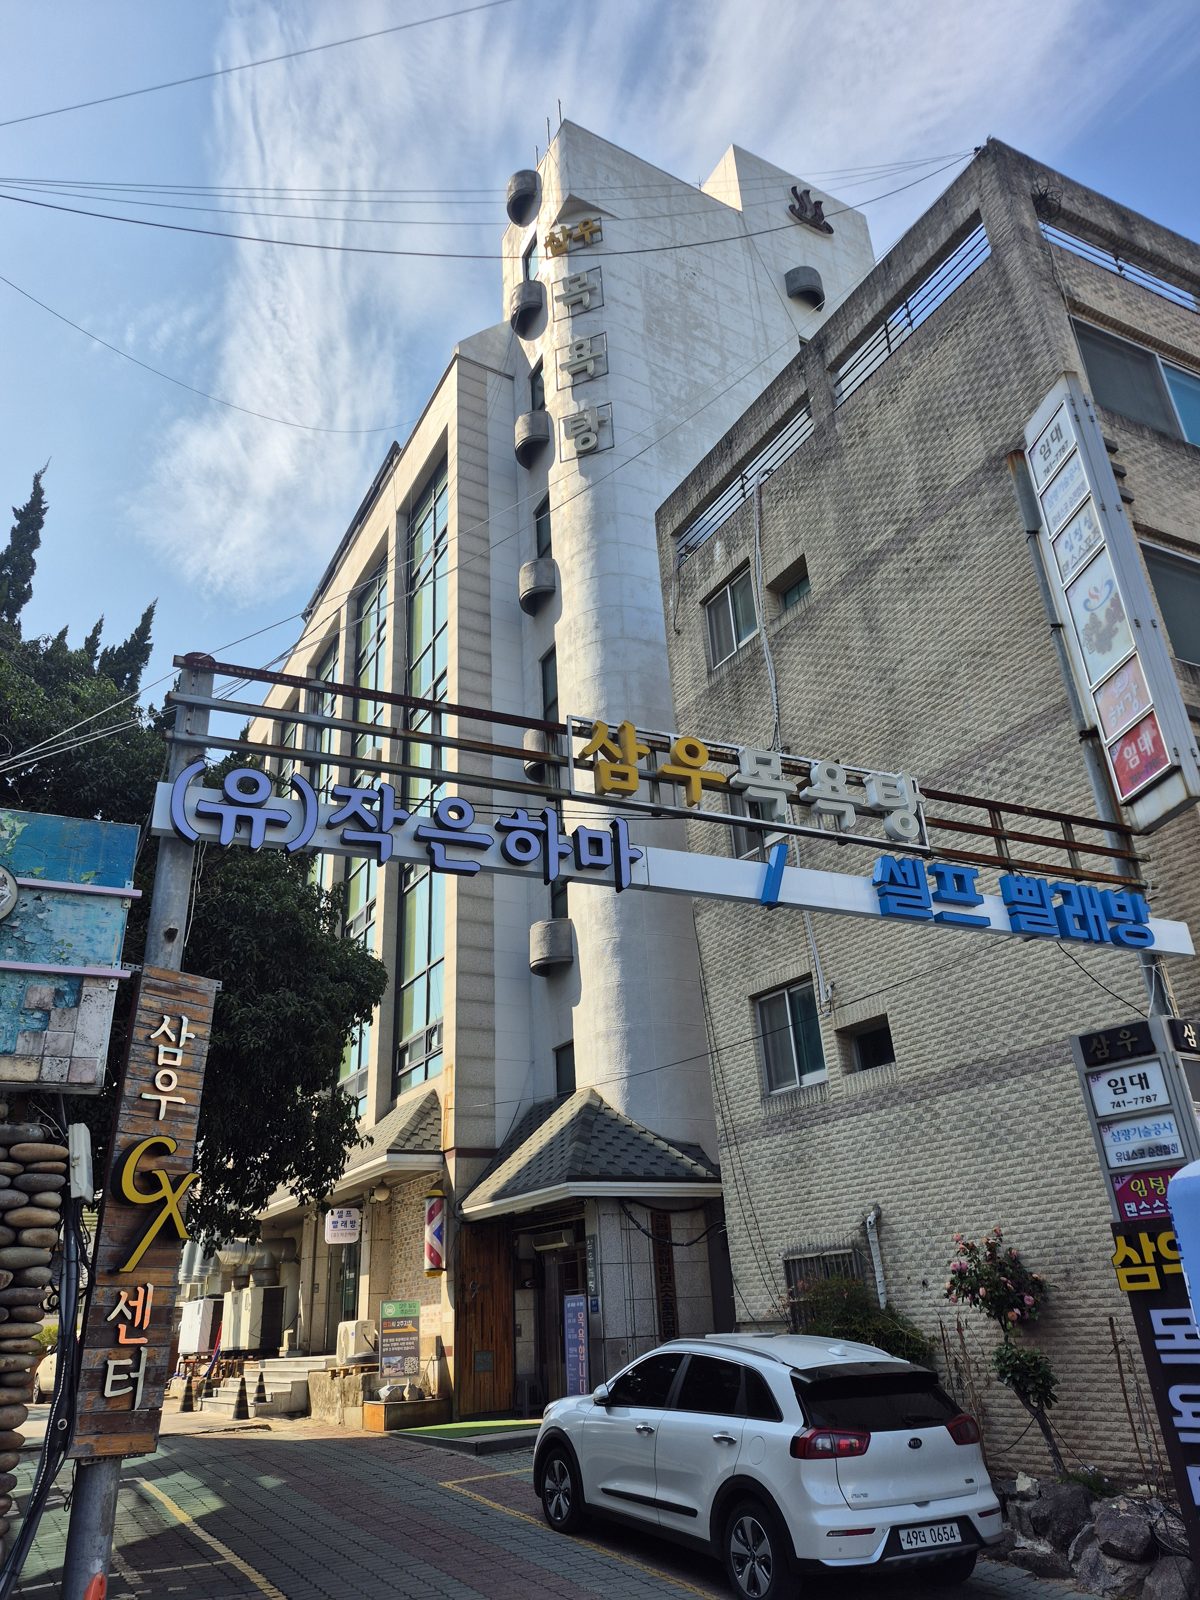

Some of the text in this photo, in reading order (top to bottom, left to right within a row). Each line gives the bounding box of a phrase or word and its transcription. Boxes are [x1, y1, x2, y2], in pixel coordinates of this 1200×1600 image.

[554, 271, 607, 451] 목욕탕
[1040, 422, 1063, 461] 임대
[1123, 730, 1155, 769] 임대
[873, 855, 991, 929] 셀프
[1000, 873, 1156, 949] 빨래방
[1090, 1029, 1138, 1059] 삼우
[1183, 1024, 1197, 1048] 삼
[141, 1014, 195, 1121] 삼우
[1107, 1072, 1150, 1095] 임대
[1110, 1094, 1158, 1109] 741-7787
[1110, 1121, 1174, 1142] 삼광기술공사
[1115, 1149, 1146, 1163] 유네스코
[1114, 1175, 1126, 1184] 4F
[1130, 1175, 1172, 1197] 임정
[336, 1210, 353, 1219] 셀프
[1124, 1199, 1171, 1217] 댄스스
[331, 1220, 357, 1229] 빨래방
[104, 1281, 154, 1411] 센터
[930, 1525, 956, 1544] 0654
